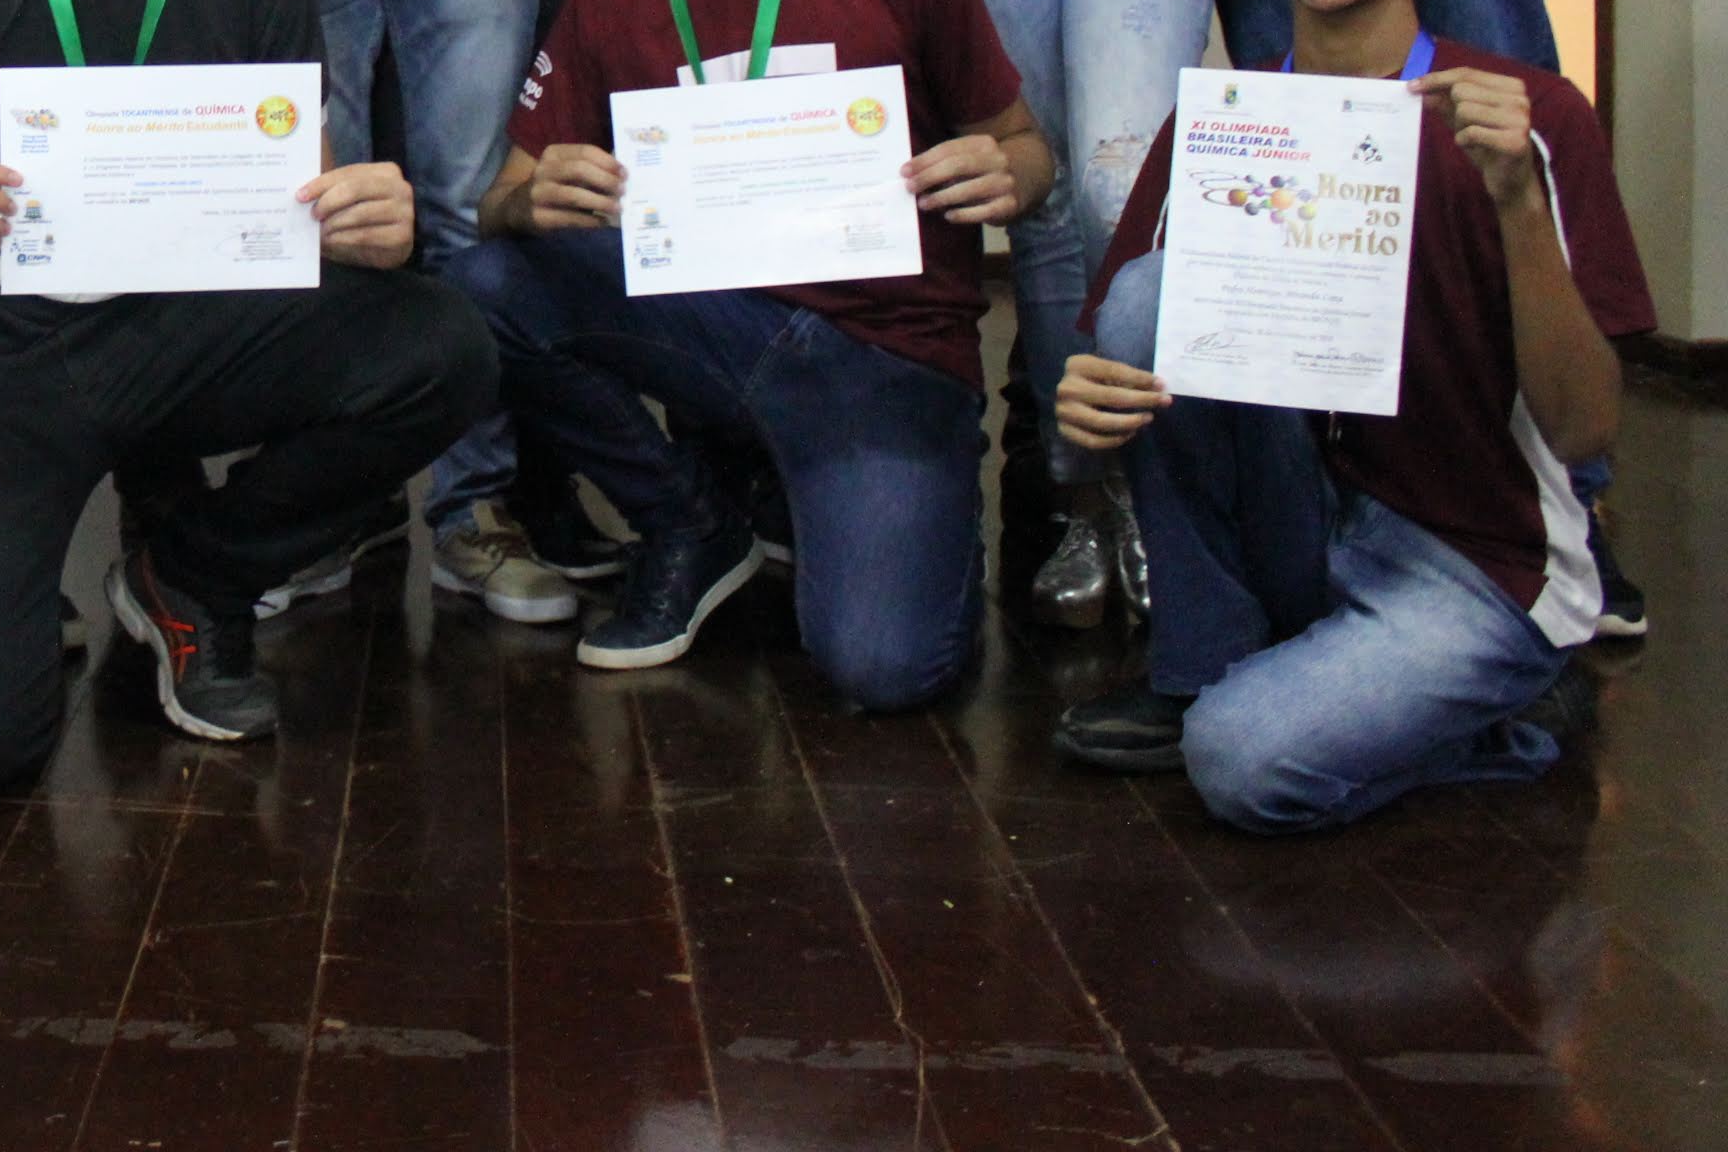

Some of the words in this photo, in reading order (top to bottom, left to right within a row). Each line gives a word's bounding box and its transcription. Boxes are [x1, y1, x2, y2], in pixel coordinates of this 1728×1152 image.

[195, 103, 247, 117] QUÍMICA
[144, 121, 185, 133] Mérito
[1190, 120, 1206, 131] XI
[1209, 121, 1291, 137] OLIMPÍADA
[1186, 131, 1273, 147] BRASILEIRA
[1277, 137, 1299, 148] DE
[1186, 142, 1249, 158] QUÍMICA
[1315, 172, 1402, 205] Honra
[1365, 207, 1401, 228] ao
